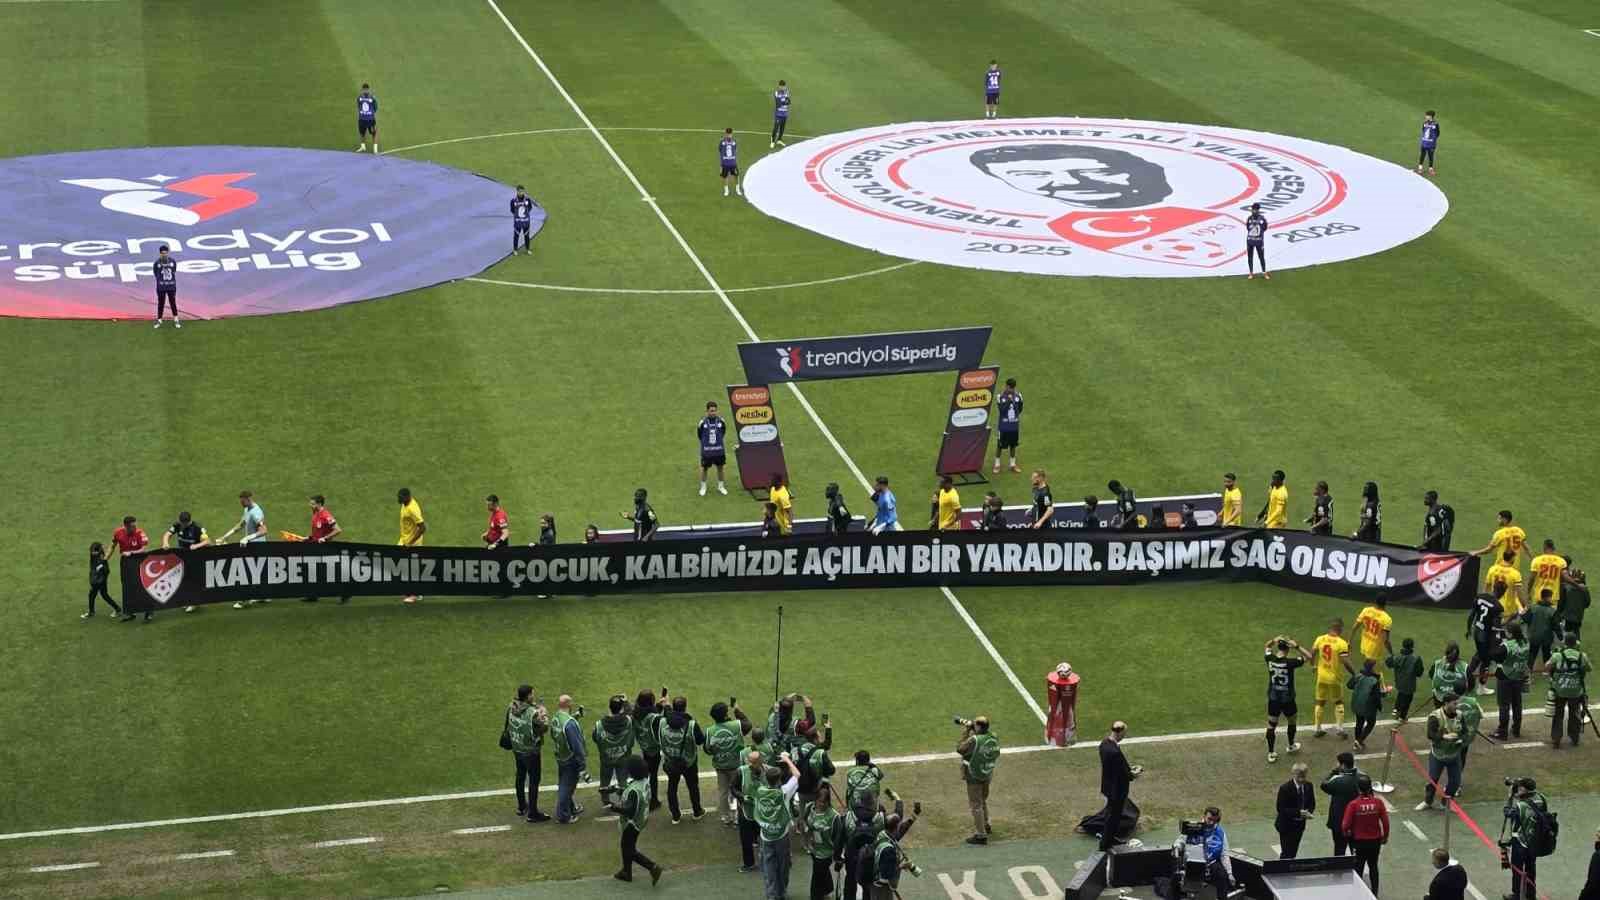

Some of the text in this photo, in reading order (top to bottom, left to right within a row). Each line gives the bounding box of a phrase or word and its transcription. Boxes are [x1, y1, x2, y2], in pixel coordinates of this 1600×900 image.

[936, 129, 1112, 140] MEHMET
[1272, 222, 1361, 243] 2026
[964, 242, 1073, 256] 2025
[806, 345, 889, 367] trendyol
[205, 535, 1396, 588] KAYBETTİĞİMİZ HER ÇOCUK, KALBİMİZDE AÇILAN BİR YARADIR. BAŞIMIZ SAĞ OLSUN.
[1322, 644, 1332, 662] 9
